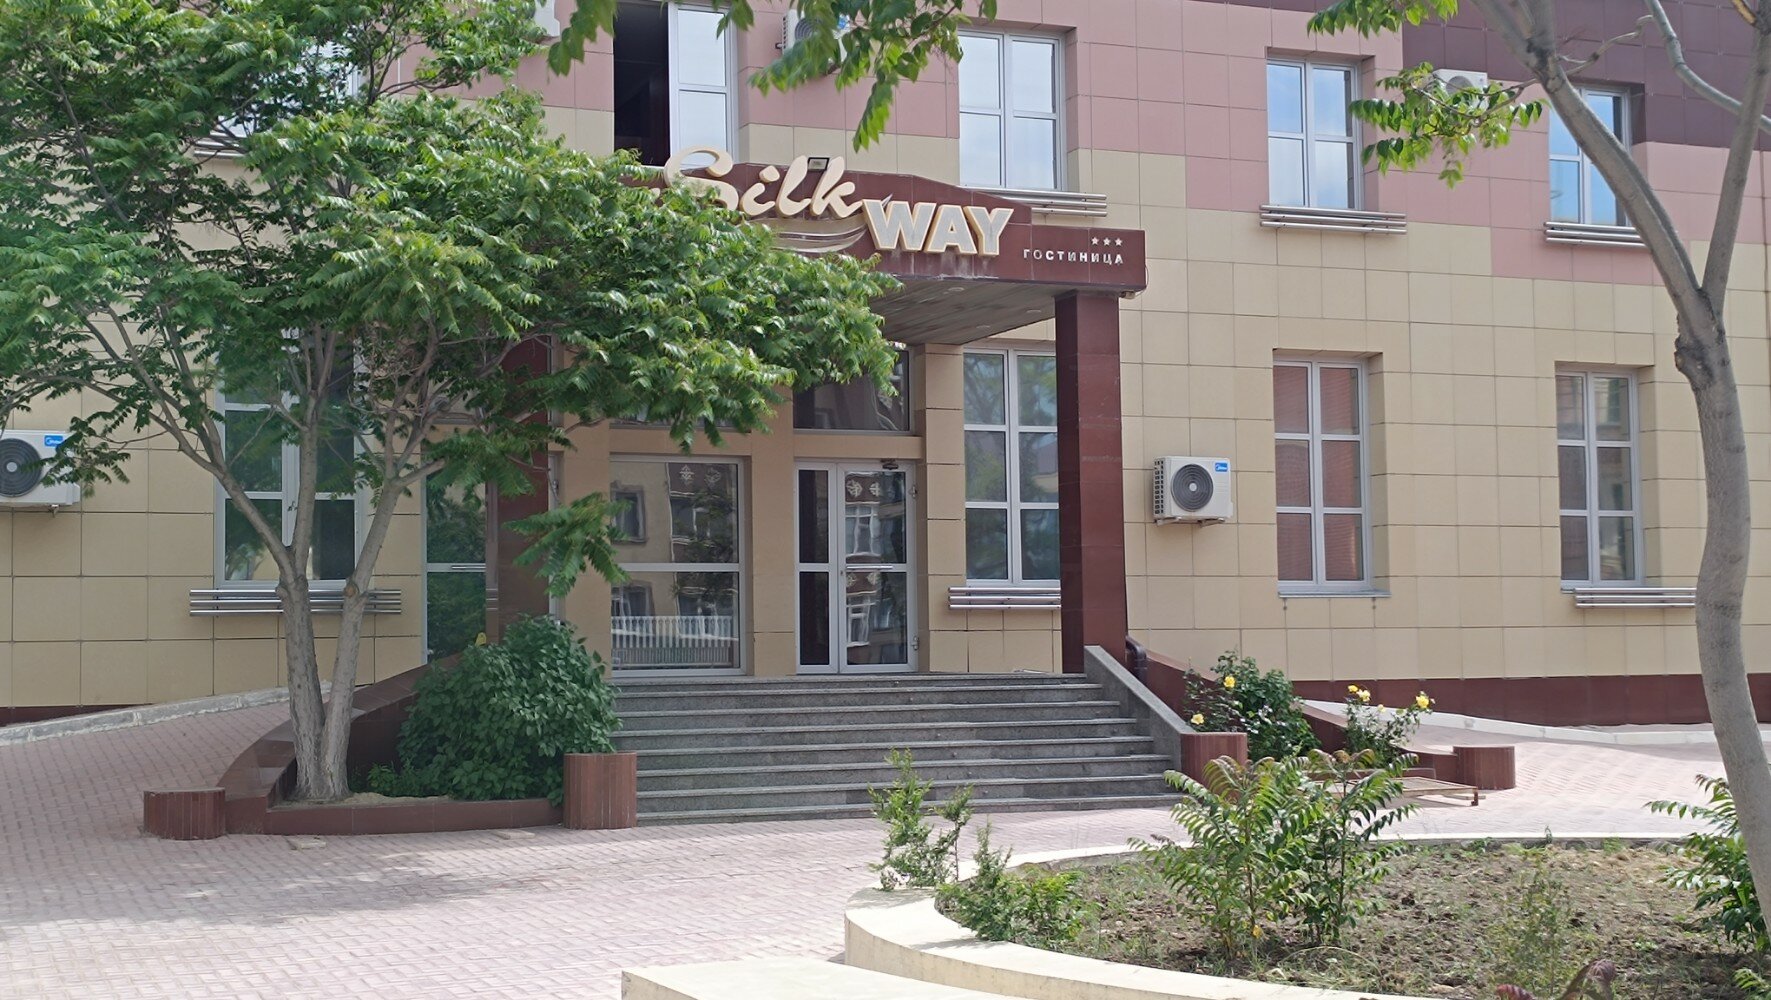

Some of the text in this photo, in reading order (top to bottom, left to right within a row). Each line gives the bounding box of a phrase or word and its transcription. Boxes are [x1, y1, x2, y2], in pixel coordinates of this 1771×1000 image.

[655, 145, 863, 218] Silk
[862, 199, 1014, 257] WAY
[1023, 249, 1124, 265] ГОСТИНИЦА
